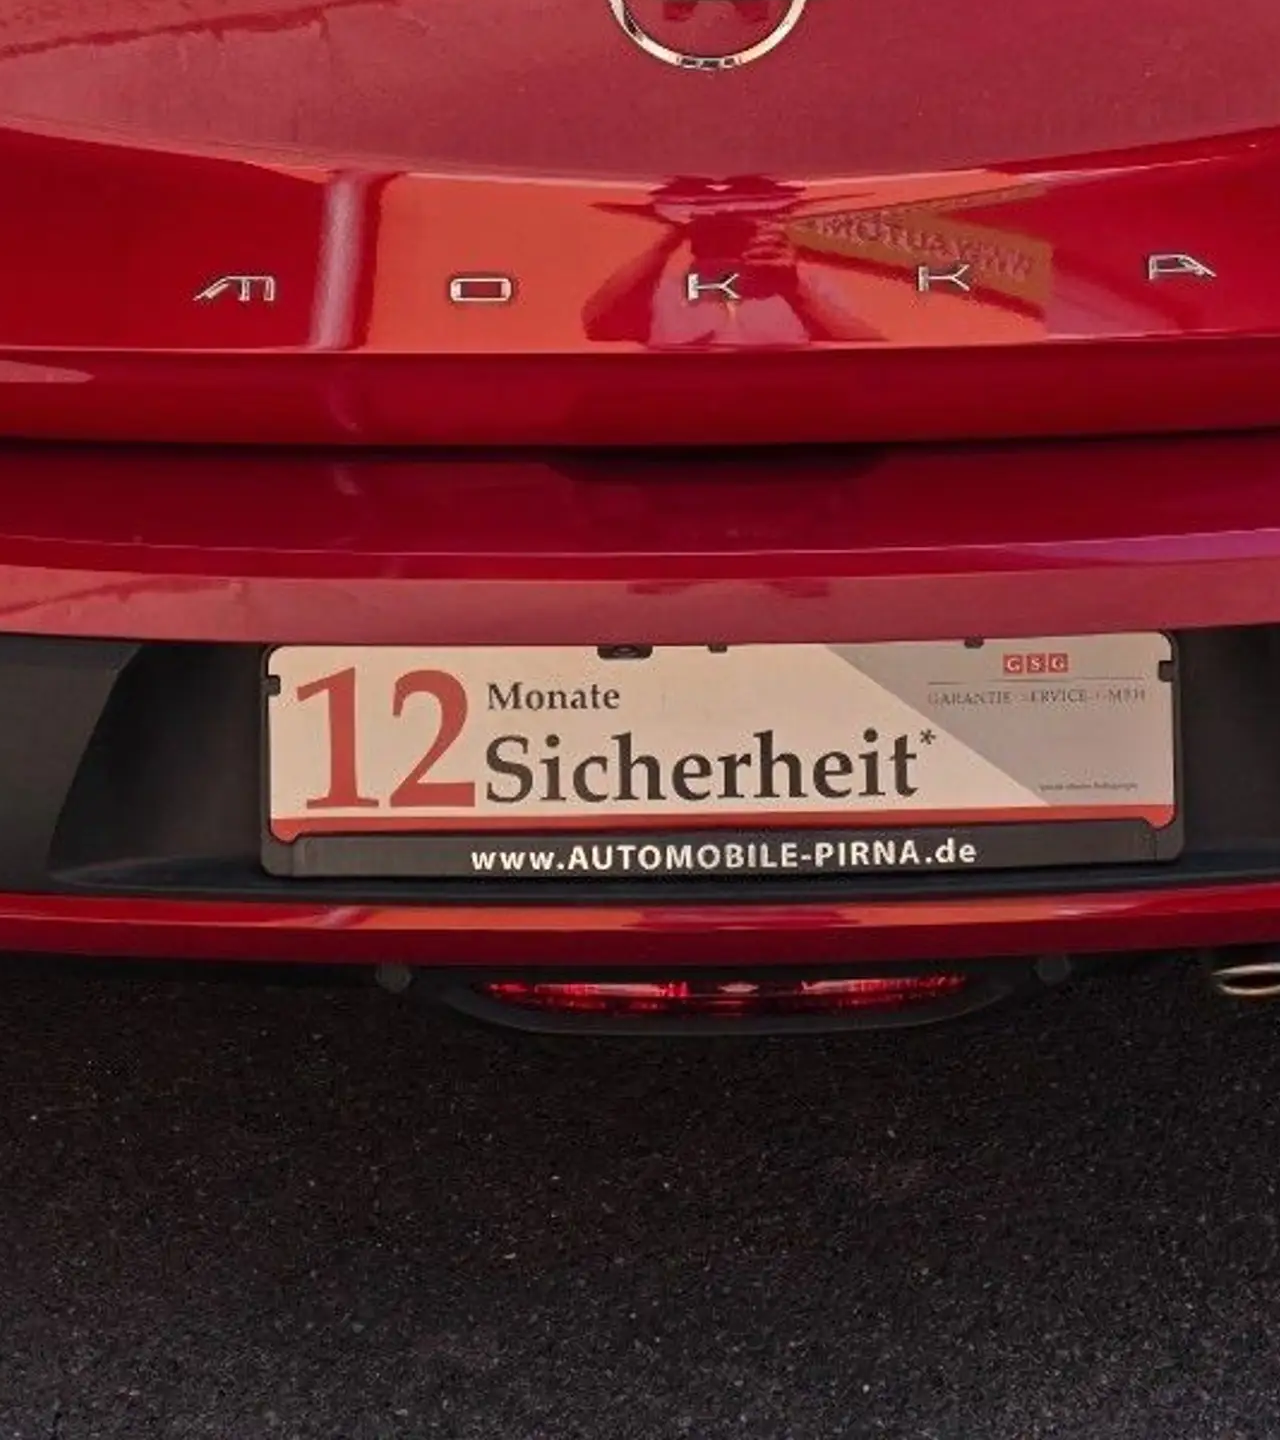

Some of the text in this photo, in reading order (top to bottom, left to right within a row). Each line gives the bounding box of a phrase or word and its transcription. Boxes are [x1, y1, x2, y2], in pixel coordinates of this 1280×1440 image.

[193, 253, 1217, 302] MOKKA
[1005, 655, 1066, 672] GSG
[487, 682, 620, 711] Monate
[296, 666, 476, 809] 12
[471, 837, 977, 871] www.AUTOMOBILE-PIRNA.de
